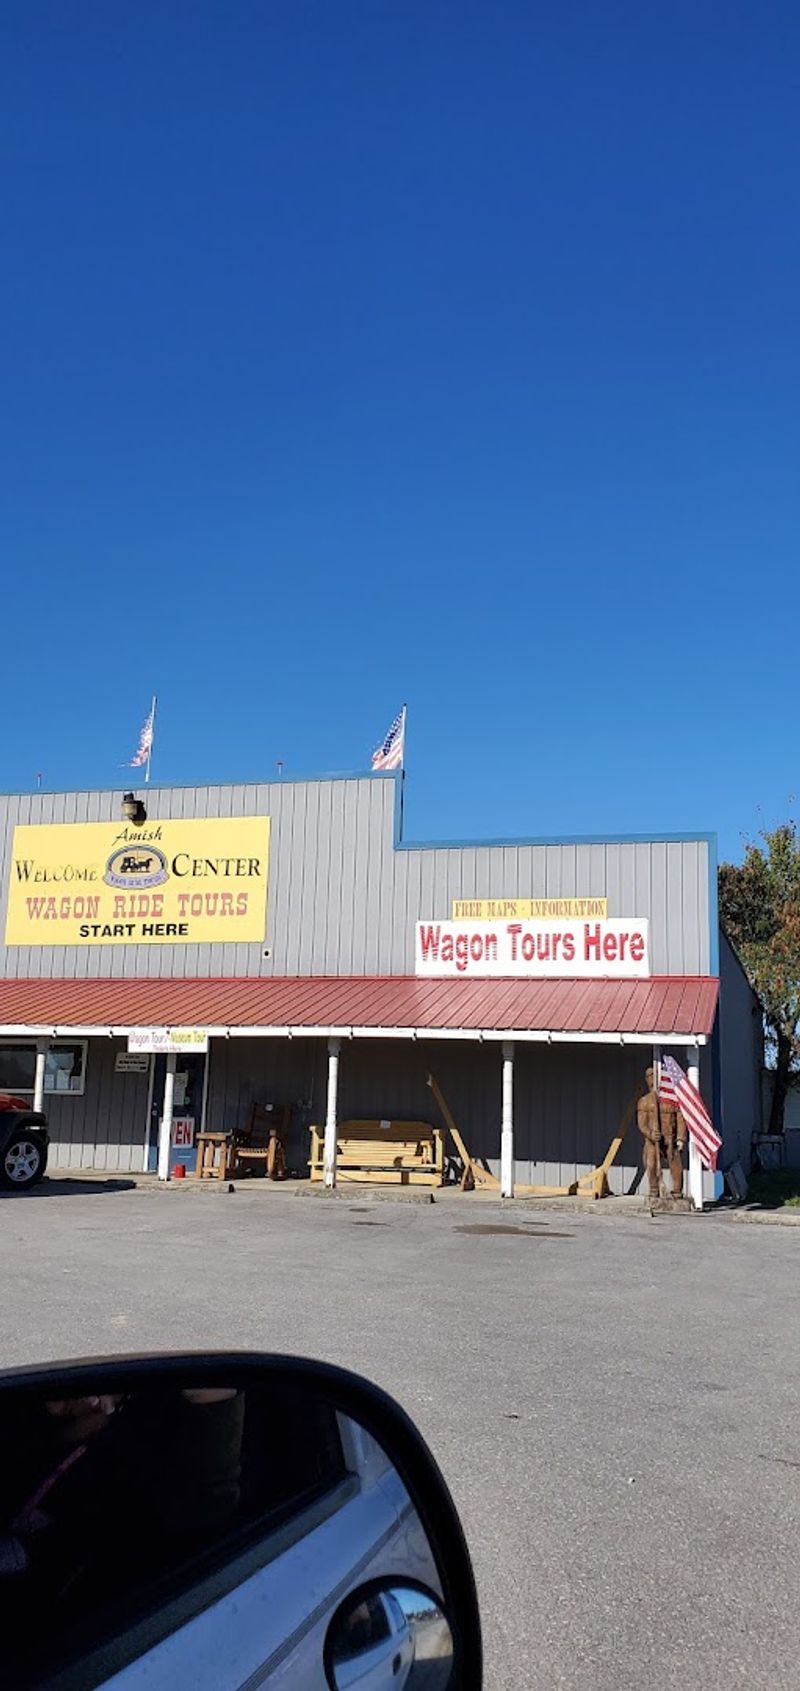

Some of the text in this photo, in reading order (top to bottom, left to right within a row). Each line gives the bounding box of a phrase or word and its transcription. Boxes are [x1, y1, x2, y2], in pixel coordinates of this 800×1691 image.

[111, 826, 163, 846] Amish
[171, 853, 262, 877] CENTER
[25, 892, 249, 920] WAGON RIDE TOURS
[454, 900, 605, 917] FREE MAPS INFORMATION
[79, 923, 189, 938] START HERE
[419, 923, 645, 971] Wagon Tours Here
